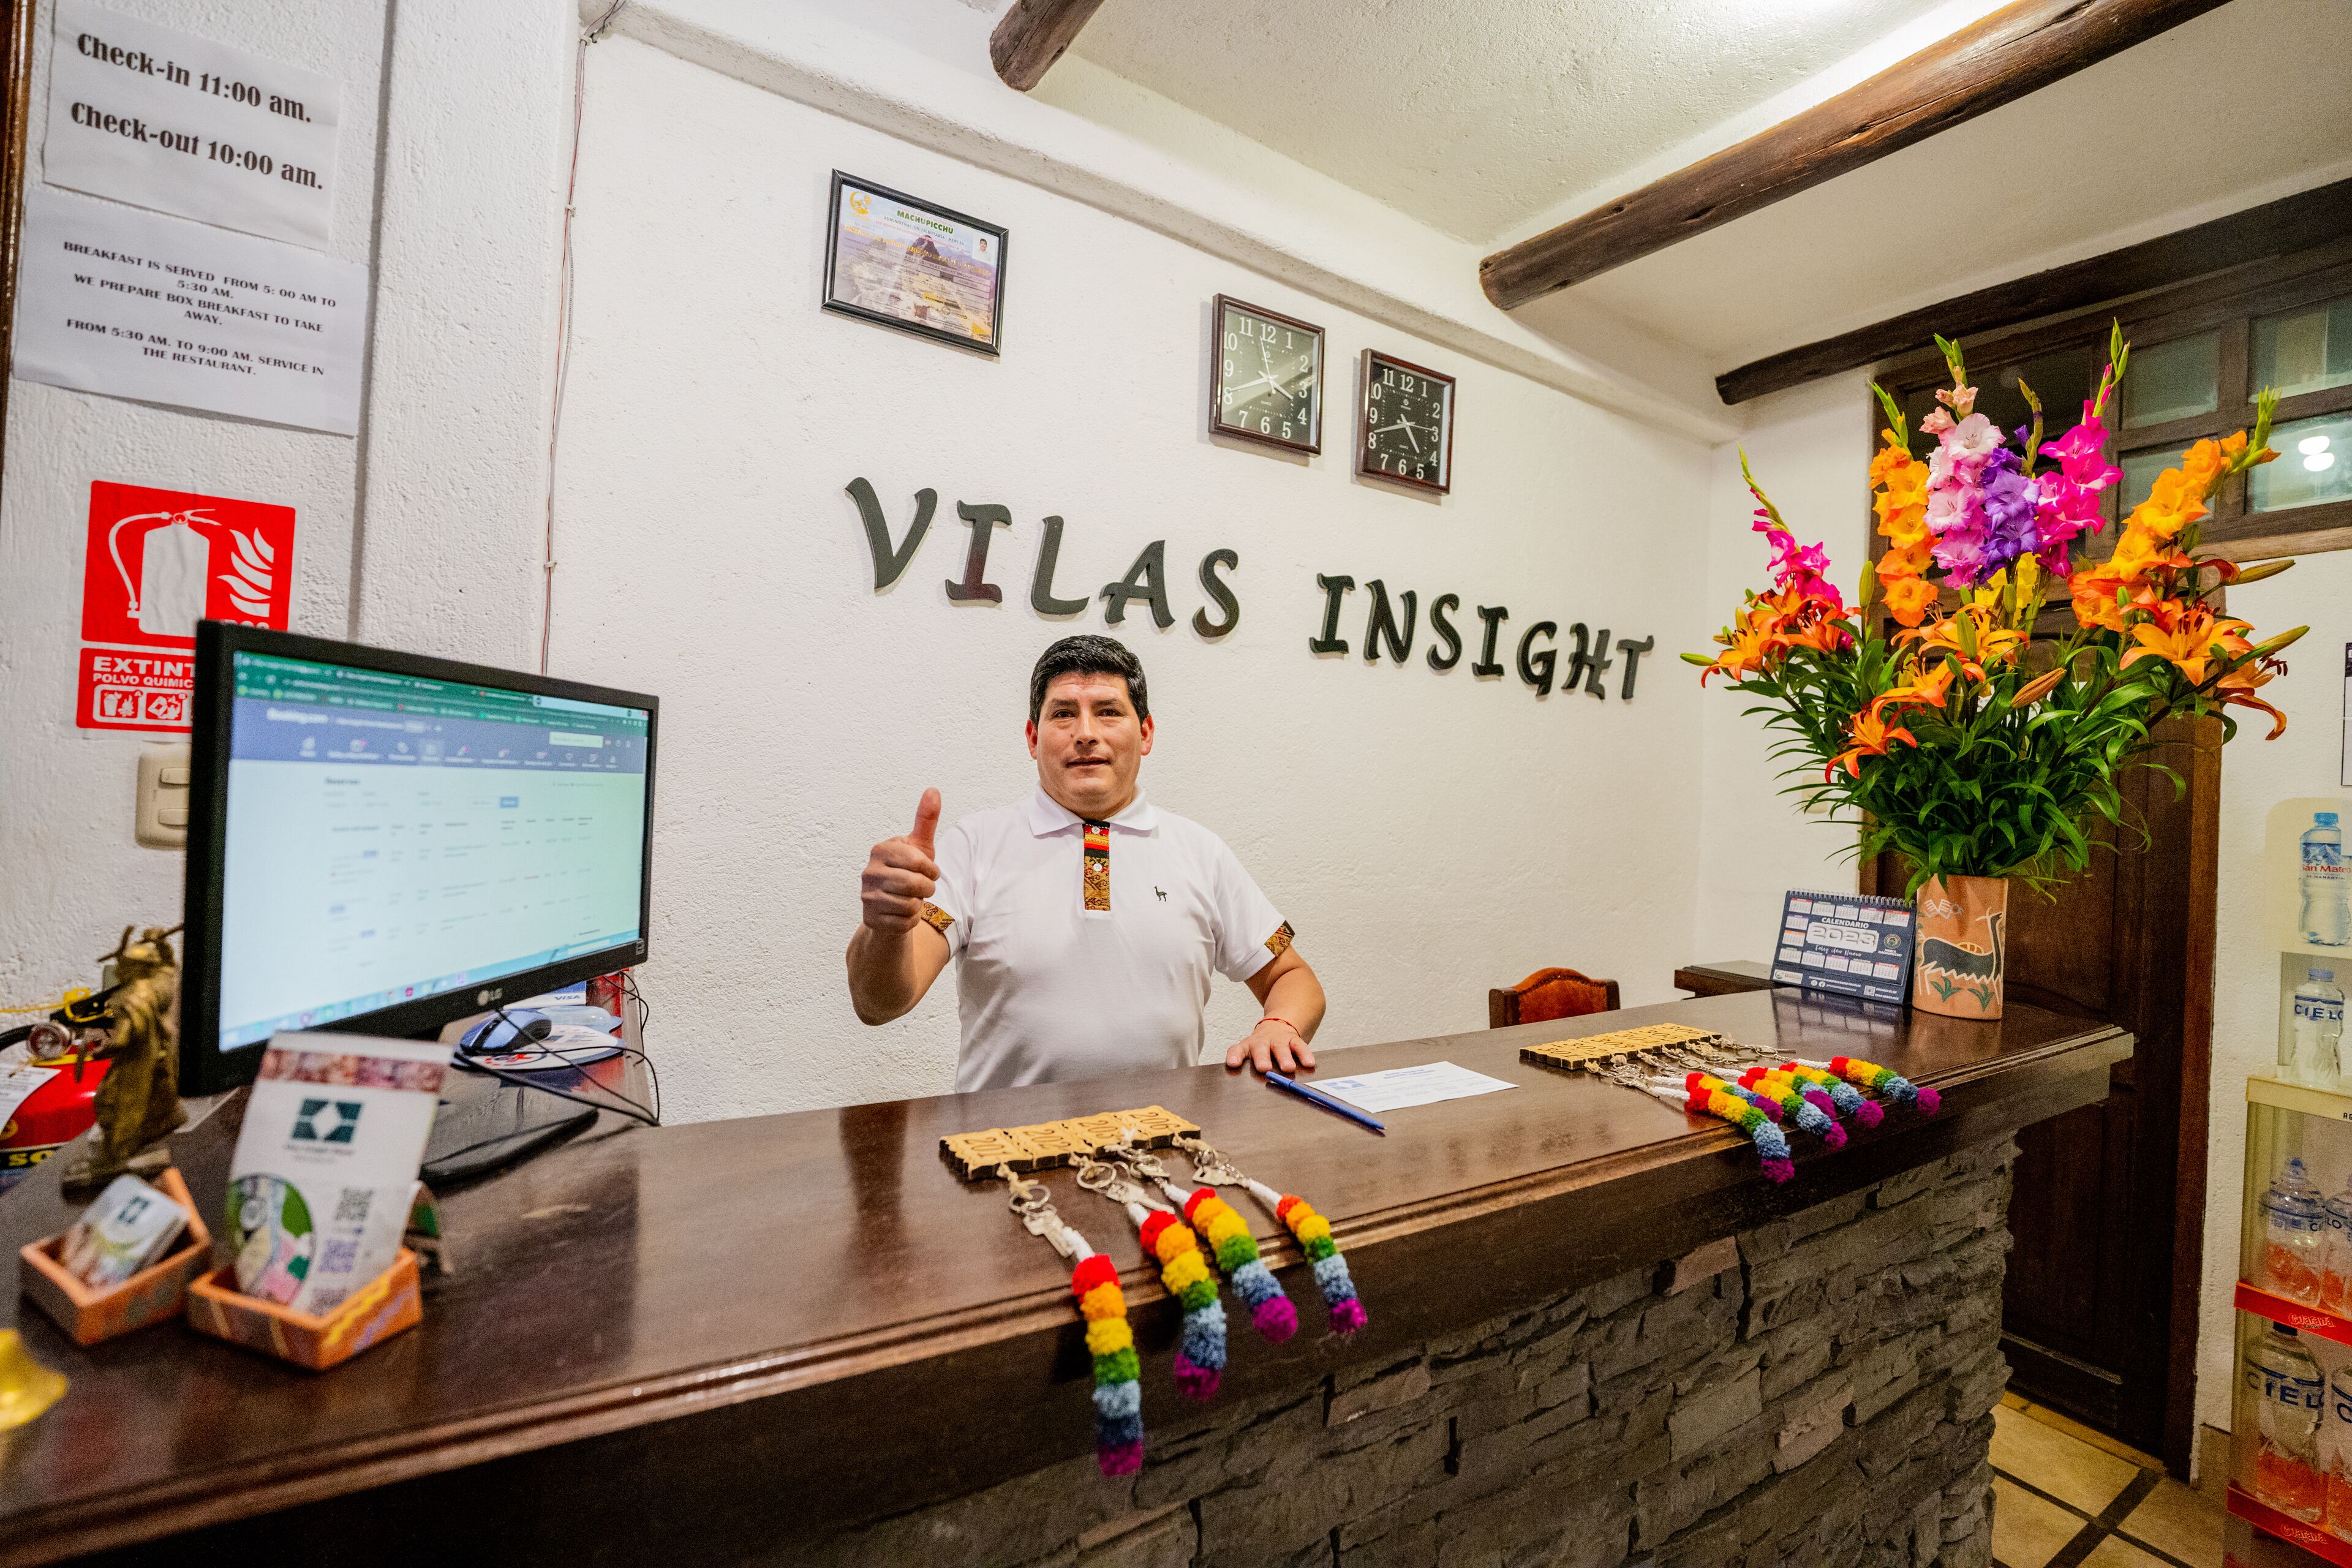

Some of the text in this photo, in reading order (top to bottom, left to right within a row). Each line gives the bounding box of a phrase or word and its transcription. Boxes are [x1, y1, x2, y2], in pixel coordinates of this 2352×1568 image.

[77, 32, 311, 123] Check-in 11:00 am.
[71, 102, 323, 189] Check-out 10:00 am.
[897, 210, 954, 234] MACHUPICCHU
[921, 228, 945, 239] TRIBUTARIA
[948, 237, 964, 246] RENTAS
[63, 241, 337, 308] BREAKFAST IS SERVED FROM 5: 00 AM TO
[177, 279, 235, 300] 5:30 AM.
[74, 274, 325, 333] WE PREPARE BOX BREAKFAST TO TAKE
[184, 310, 224, 326] AWAY.
[1239, 317, 1253, 337] 11
[1223, 331, 1238, 351] 10
[1261, 323, 1276, 344] 12
[1286, 331, 1293, 349] 1
[66, 318, 325, 375] FROM 5:30 AM. TO 9:00 AM. SERVICE IN
[142, 346, 257, 376] THE RESTAURANT.
[1224, 360, 1234, 377] 9
[1300, 355, 1308, 373] 2
[1382, 368, 1395, 387] 11
[1400, 374, 1414, 393] 12
[1223, 386, 1233, 405] 8
[1298, 382, 1308, 398] 3
[1371, 382, 1382, 400] 10
[1422, 382, 1428, 398] 1
[1238, 410, 1248, 428] 7
[1297, 407, 1307, 425] 4
[1370, 407, 1378, 424] 9
[1432, 402, 1441, 419] 2
[1261, 417, 1270, 434] 6
[1281, 421, 1291, 439] 5
[1431, 426, 1439, 442] 3
[1368, 432, 1376, 449] 8
[1380, 453, 1389, 470] 7
[1398, 459, 1407, 475] 6
[1430, 451, 1438, 467] 4
[1416, 464, 1424, 480] 5
[845, 477, 1654, 701] VILAS INSIGHT
[93, 656, 195, 677] EXTINT
[93, 673, 194, 688] POLVO QUIMIC
[1822, 917, 1869, 929] CALENDARIO
[1811, 925, 1876, 946] 2023
[1844, 948, 1862, 957] Nuevo
[1537, 1047, 1579, 1057] 301
[1129, 1112, 1180, 1130] 206
[964, 1136, 1009, 1158] 201
[1023, 1128, 1071, 1149] 202
